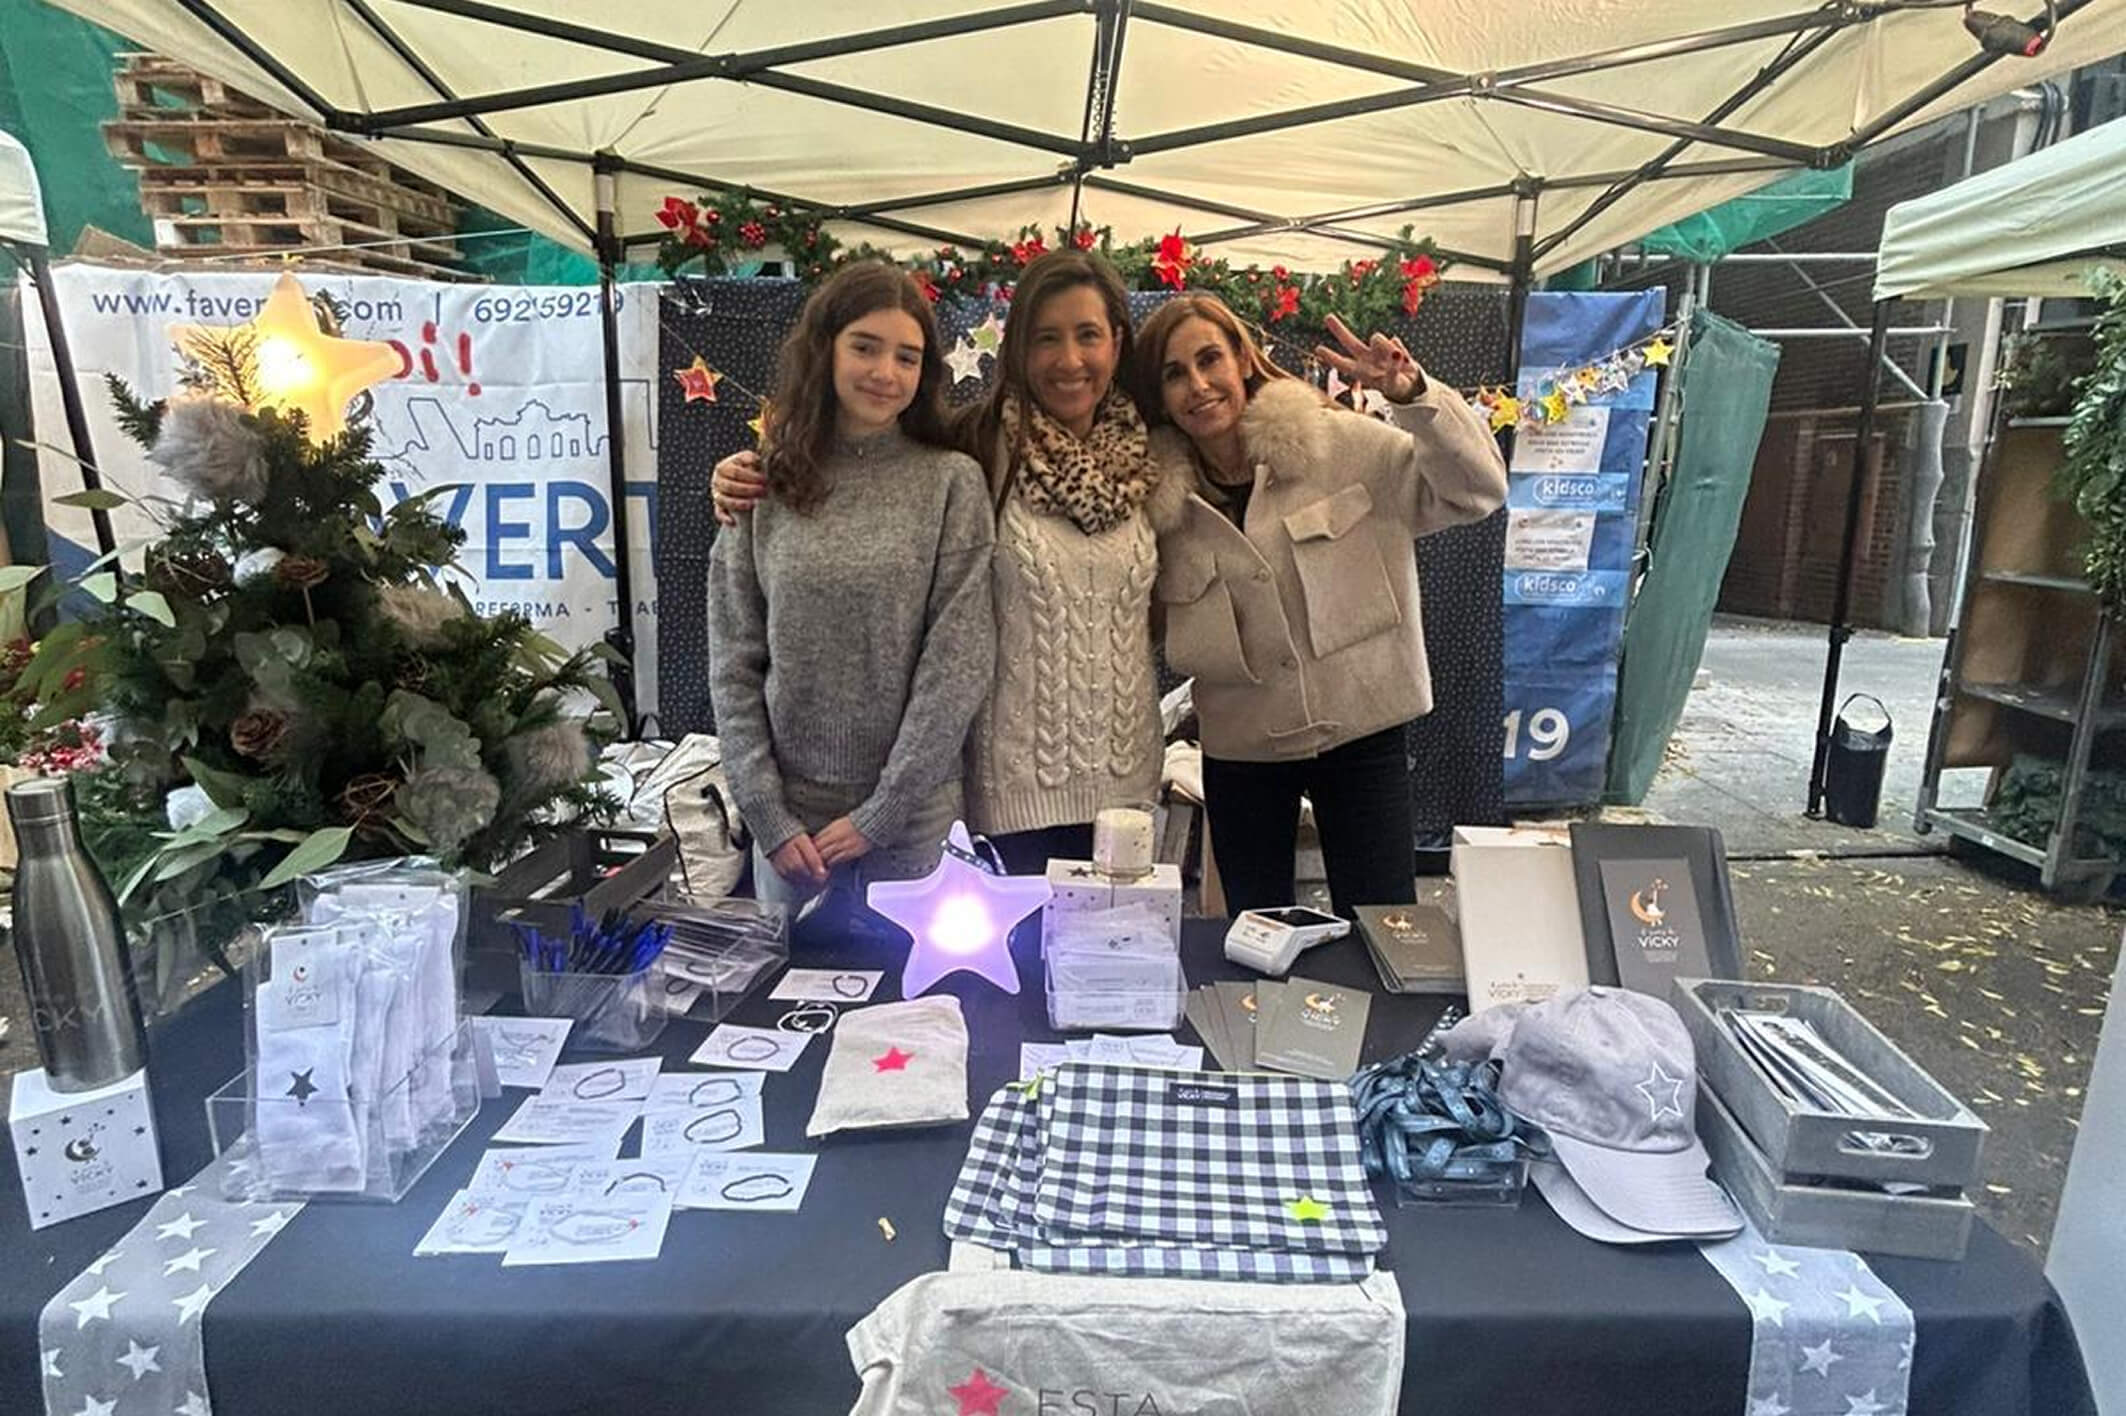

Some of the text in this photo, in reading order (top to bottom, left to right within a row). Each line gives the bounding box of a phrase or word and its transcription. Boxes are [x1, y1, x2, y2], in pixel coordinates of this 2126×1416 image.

[1503, 707, 1570, 761] 19
[1637, 935, 1680, 948] VICKY
[1038, 1387, 1164, 1416] ESTA
